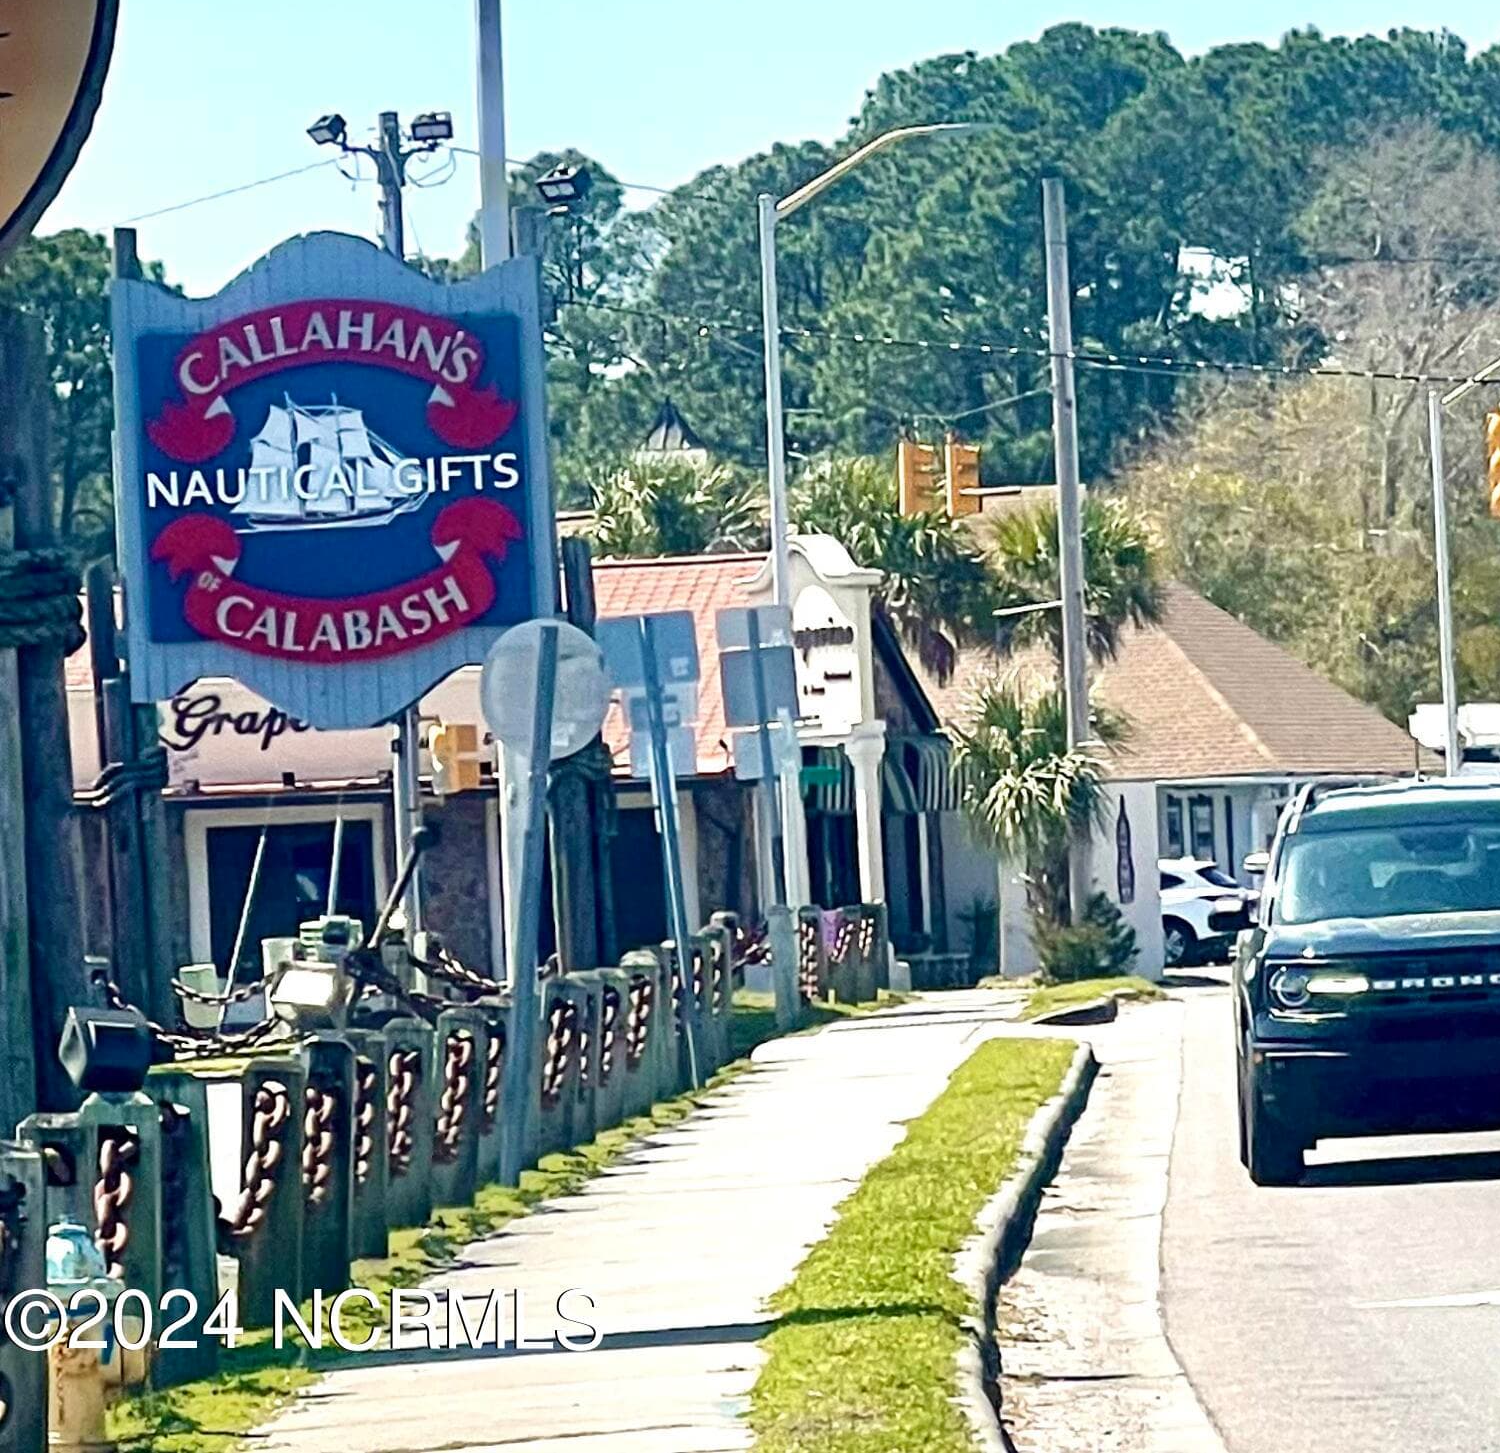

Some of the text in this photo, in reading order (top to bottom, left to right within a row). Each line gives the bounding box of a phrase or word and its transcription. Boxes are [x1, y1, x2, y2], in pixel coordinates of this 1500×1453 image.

[179, 311, 478, 395] CALLAHAN'S
[146, 452, 520, 507] NAUTICAL GIFTS
[216, 575, 470, 652] CALABASH
